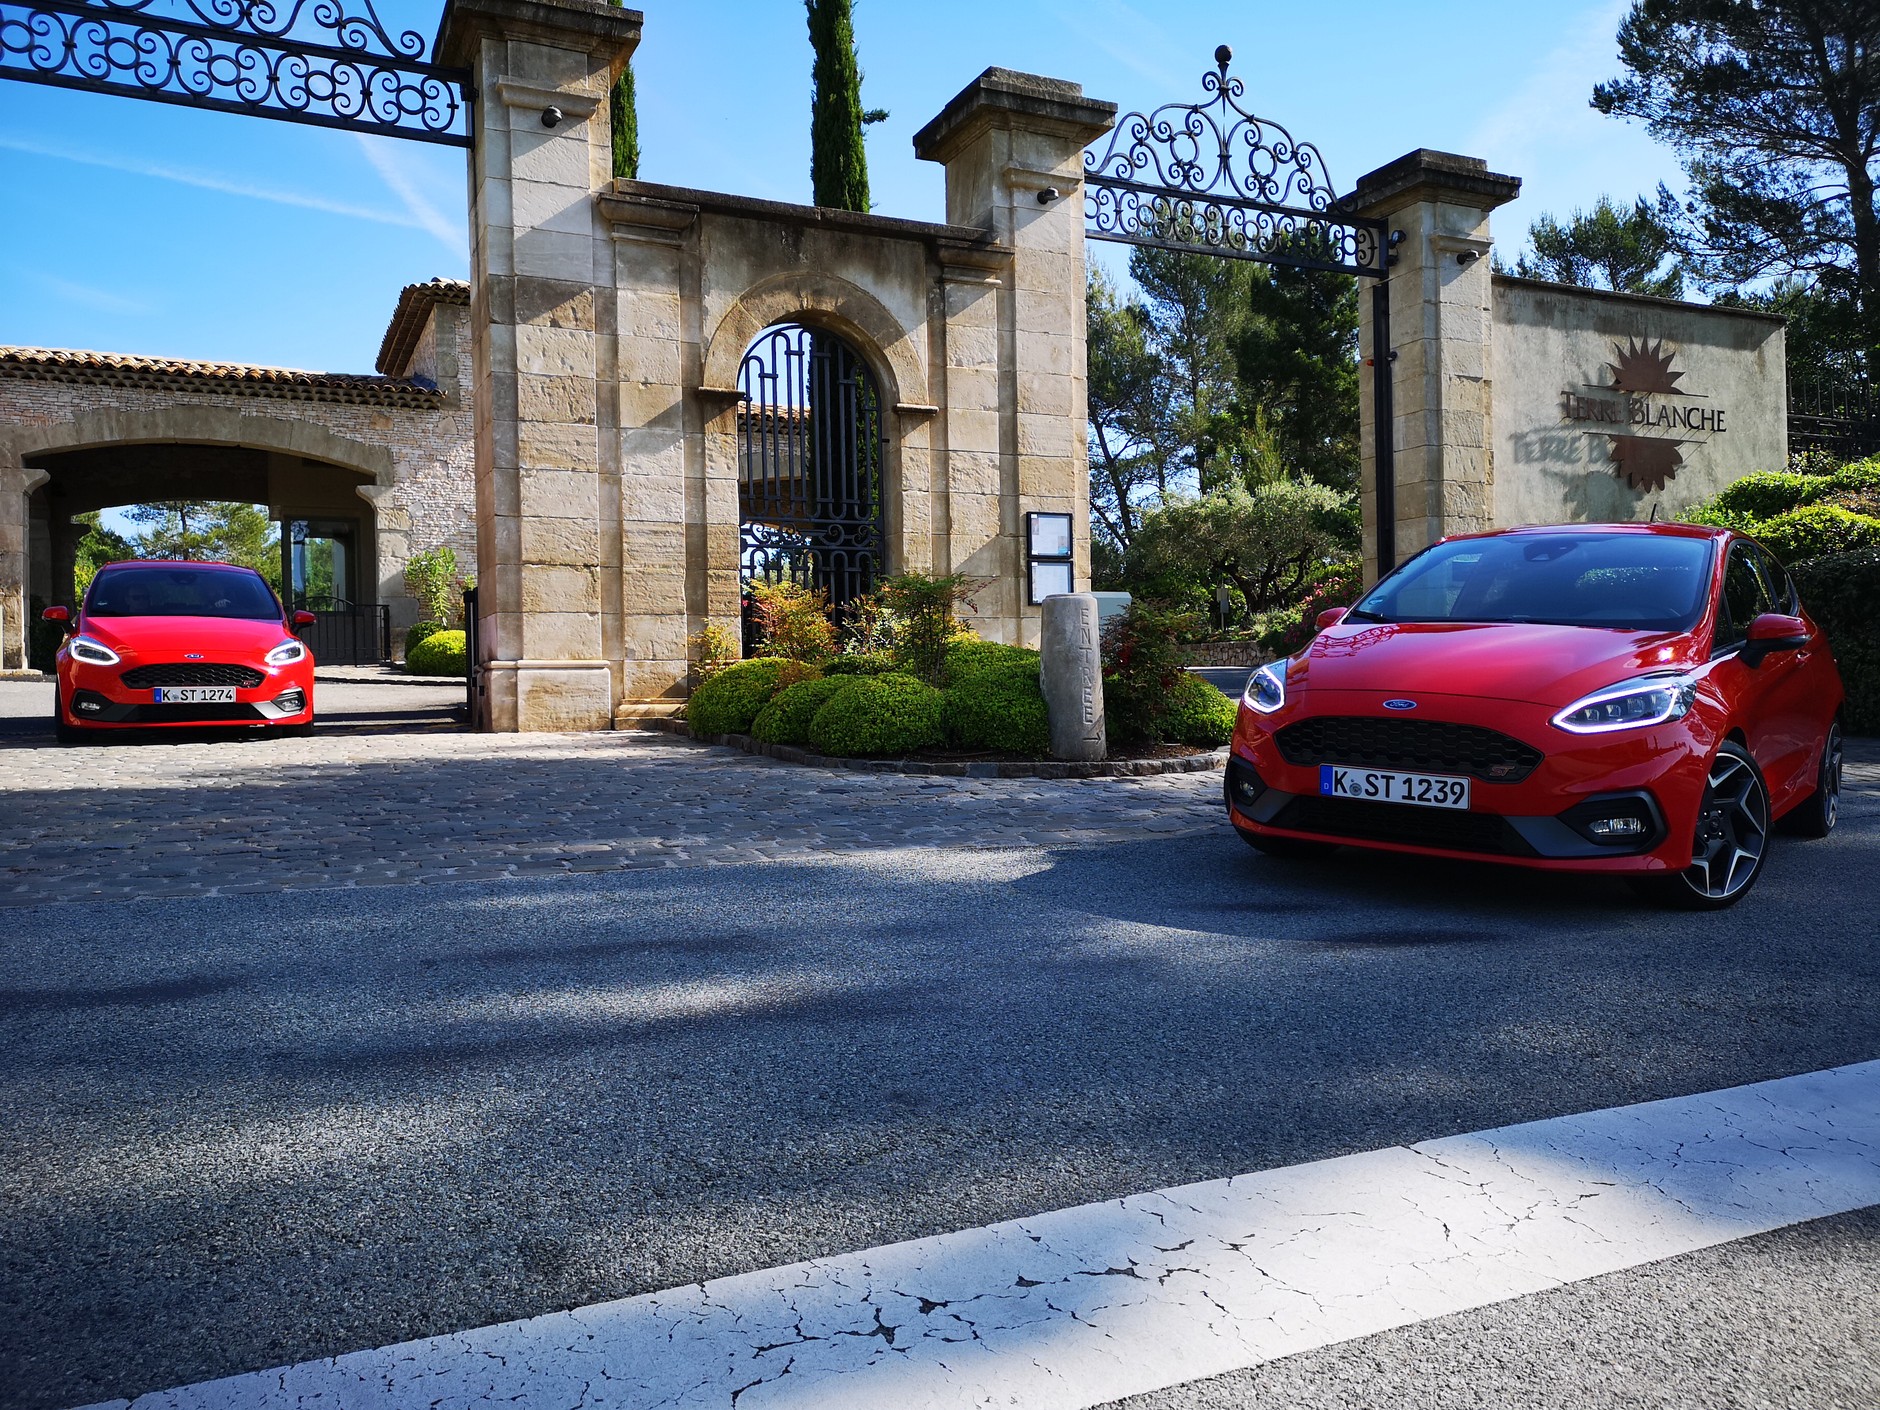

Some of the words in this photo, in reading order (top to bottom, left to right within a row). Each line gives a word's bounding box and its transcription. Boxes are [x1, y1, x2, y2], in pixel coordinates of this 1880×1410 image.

[1629, 398, 1727, 432] BLANCHE
[163, 690, 171, 701] K
[181, 690, 197, 701] ST
[201, 690, 233, 701] 1274
[1333, 770, 1348, 794] K
[1364, 773, 1395, 799] ST
[1401, 777, 1465, 805] 1239
